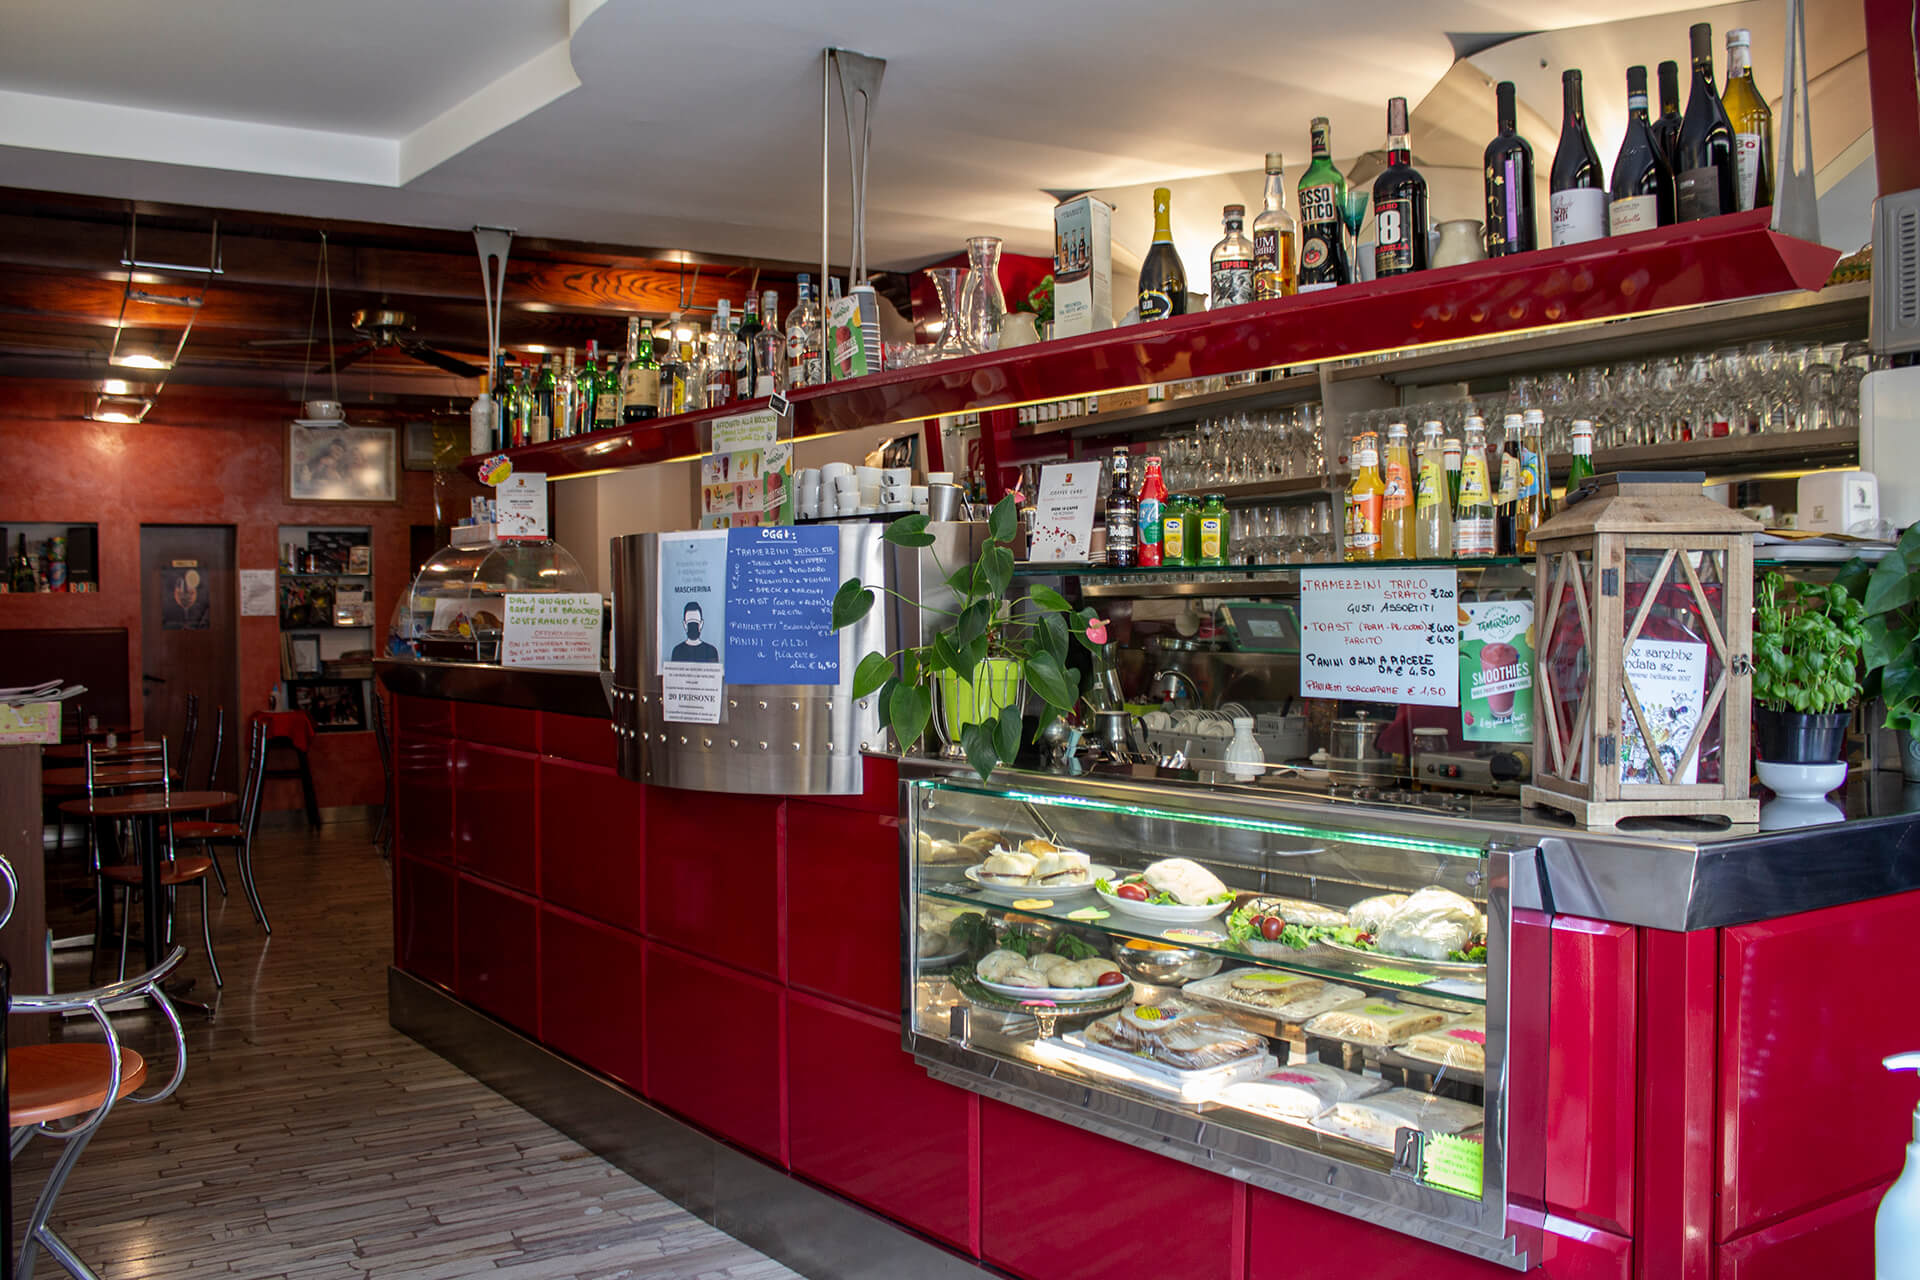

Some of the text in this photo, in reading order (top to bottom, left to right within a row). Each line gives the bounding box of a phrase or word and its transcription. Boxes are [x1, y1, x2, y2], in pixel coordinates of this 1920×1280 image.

[1300, 188, 1330, 204] OSSO
[674, 585, 712, 593] MASCHERINA
[1305, 578, 1428, 592] TRAMEZZINI TRIPLO
[1383, 590, 1426, 600] STRATO
[736, 597, 769, 605] TOAST
[1346, 602, 1434, 613] GUSTI ASSORTITI
[1312, 621, 1353, 632] TOAST
[771, 639, 808, 647] CALDI
[1305, 653, 1344, 668] PANINI
[1472, 661, 1530, 687] SMOOTHIES
[678, 694, 716, 703] PERSONE
